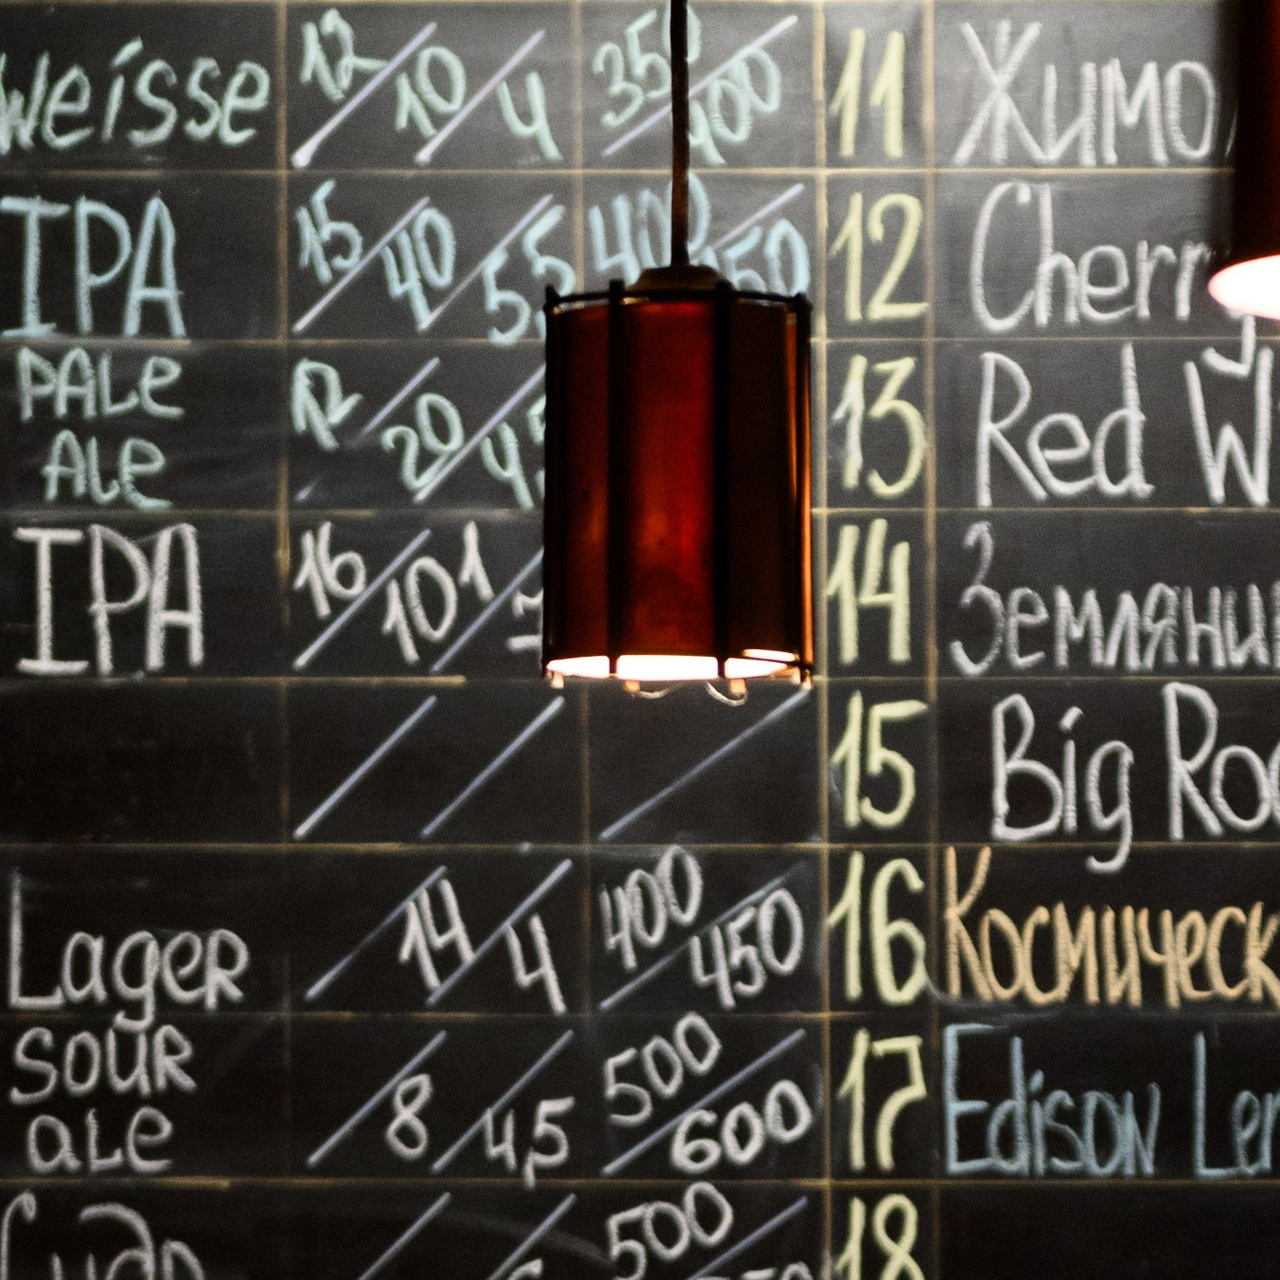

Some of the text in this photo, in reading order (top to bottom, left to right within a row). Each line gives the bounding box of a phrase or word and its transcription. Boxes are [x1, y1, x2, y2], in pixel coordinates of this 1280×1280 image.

[830, 27, 904, 159] 11
[953, 21, 1237, 166] Жимо
[2, 193, 187, 339] IPA
[830, 191, 928, 322] 12
[832, 354, 927, 497] 13
[976, 343, 1155, 508] Red
[13, 522, 203, 676] IPA
[825, 518, 910, 664] 14
[832, 691, 927, 828] 15
[991, 692, 1133, 872] Big
[400, 878, 566, 1015] 14 4
[600, 845, 703, 970] 400
[687, 888, 801, 1009] 450
[827, 852, 926, 1003] 16
[386, 1072, 432, 1159] 8
[604, 1013, 721, 1127] 500
[669, 1079, 814, 1173] 600
[839, 1027, 927, 1172] 17
[943, 1023, 1161, 1177] Edison
